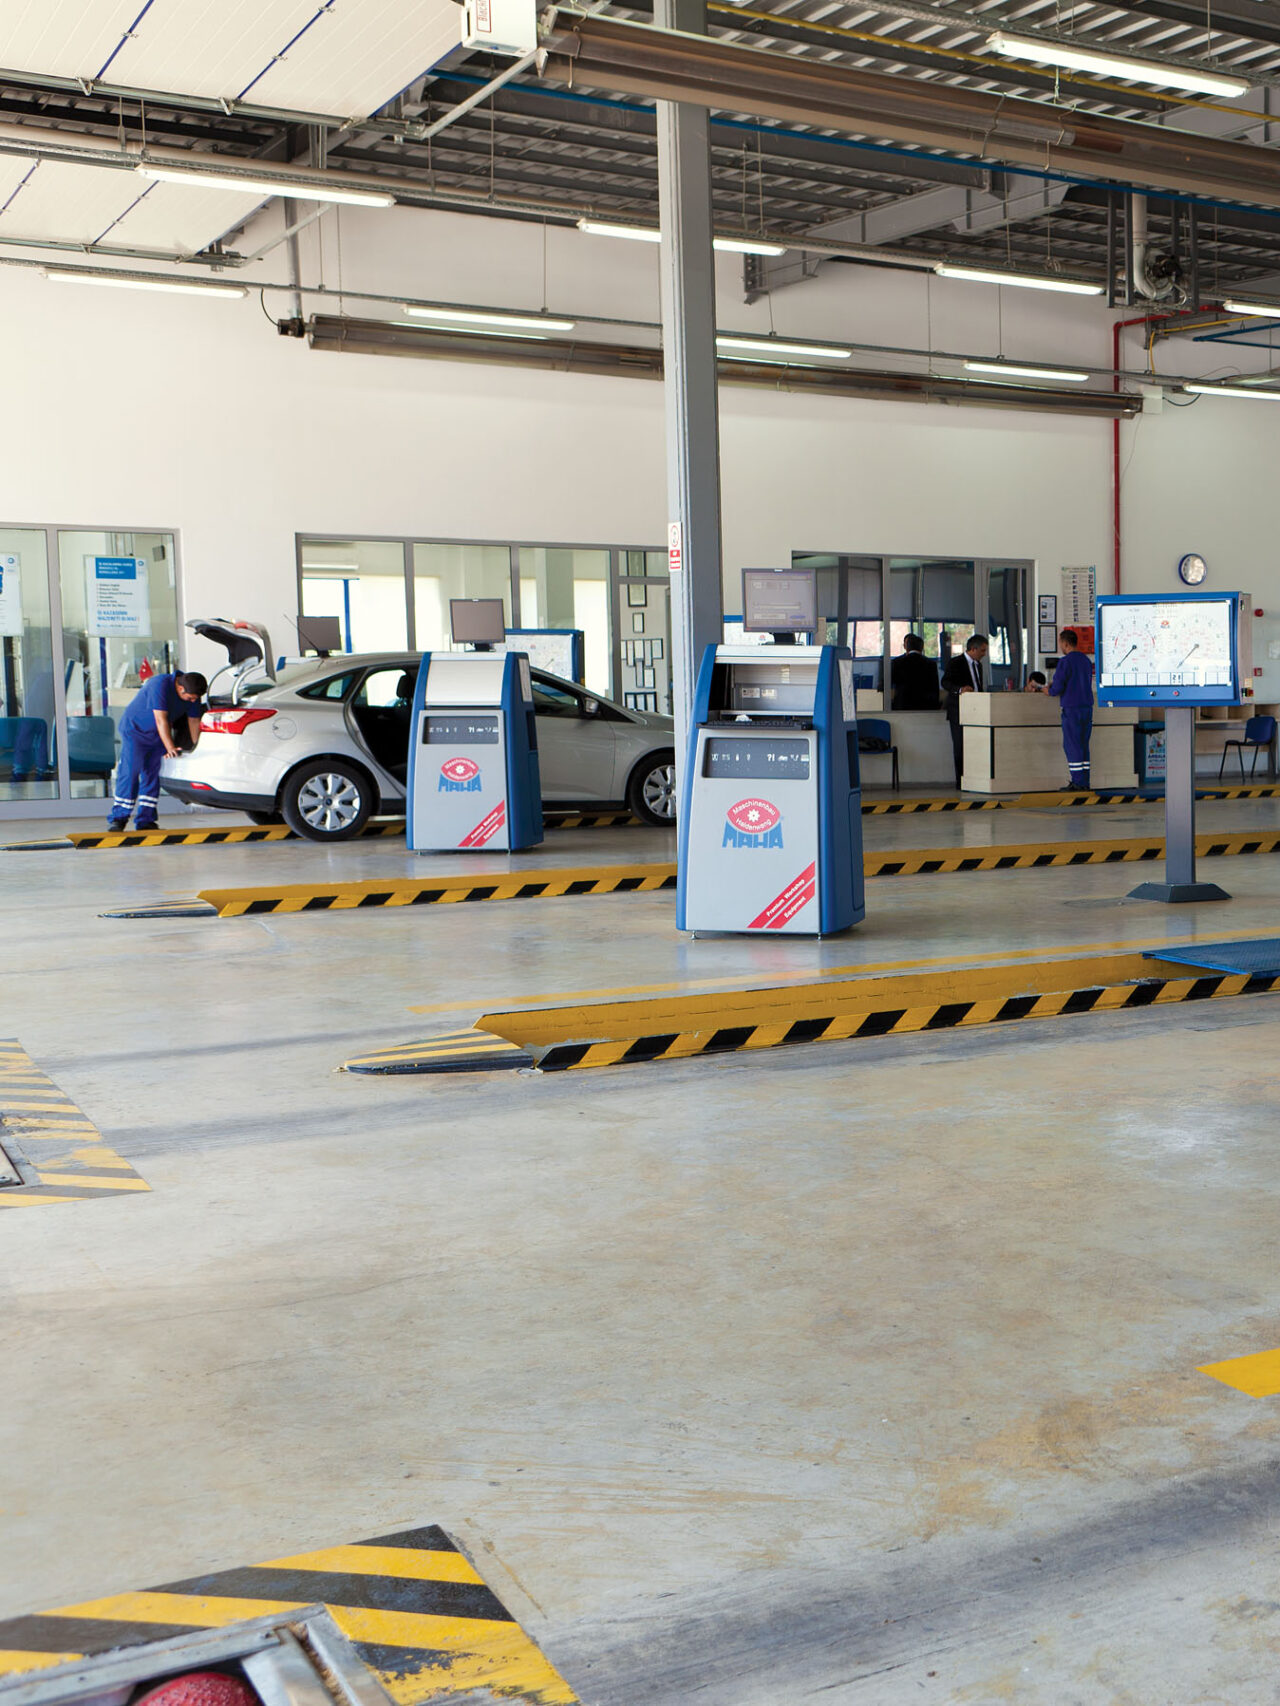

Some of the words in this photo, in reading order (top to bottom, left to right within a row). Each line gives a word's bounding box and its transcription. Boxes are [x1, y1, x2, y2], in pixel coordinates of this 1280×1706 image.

[438, 773, 482, 792] MAHA
[732, 800, 776, 816] Maschinenbau
[722, 820, 784, 848] MAHA
[736, 818, 772, 830] Haldenwang
[766, 899, 785, 917] Premium
[784, 879, 805, 899] Workshop
[784, 896, 806, 918] Equipment
